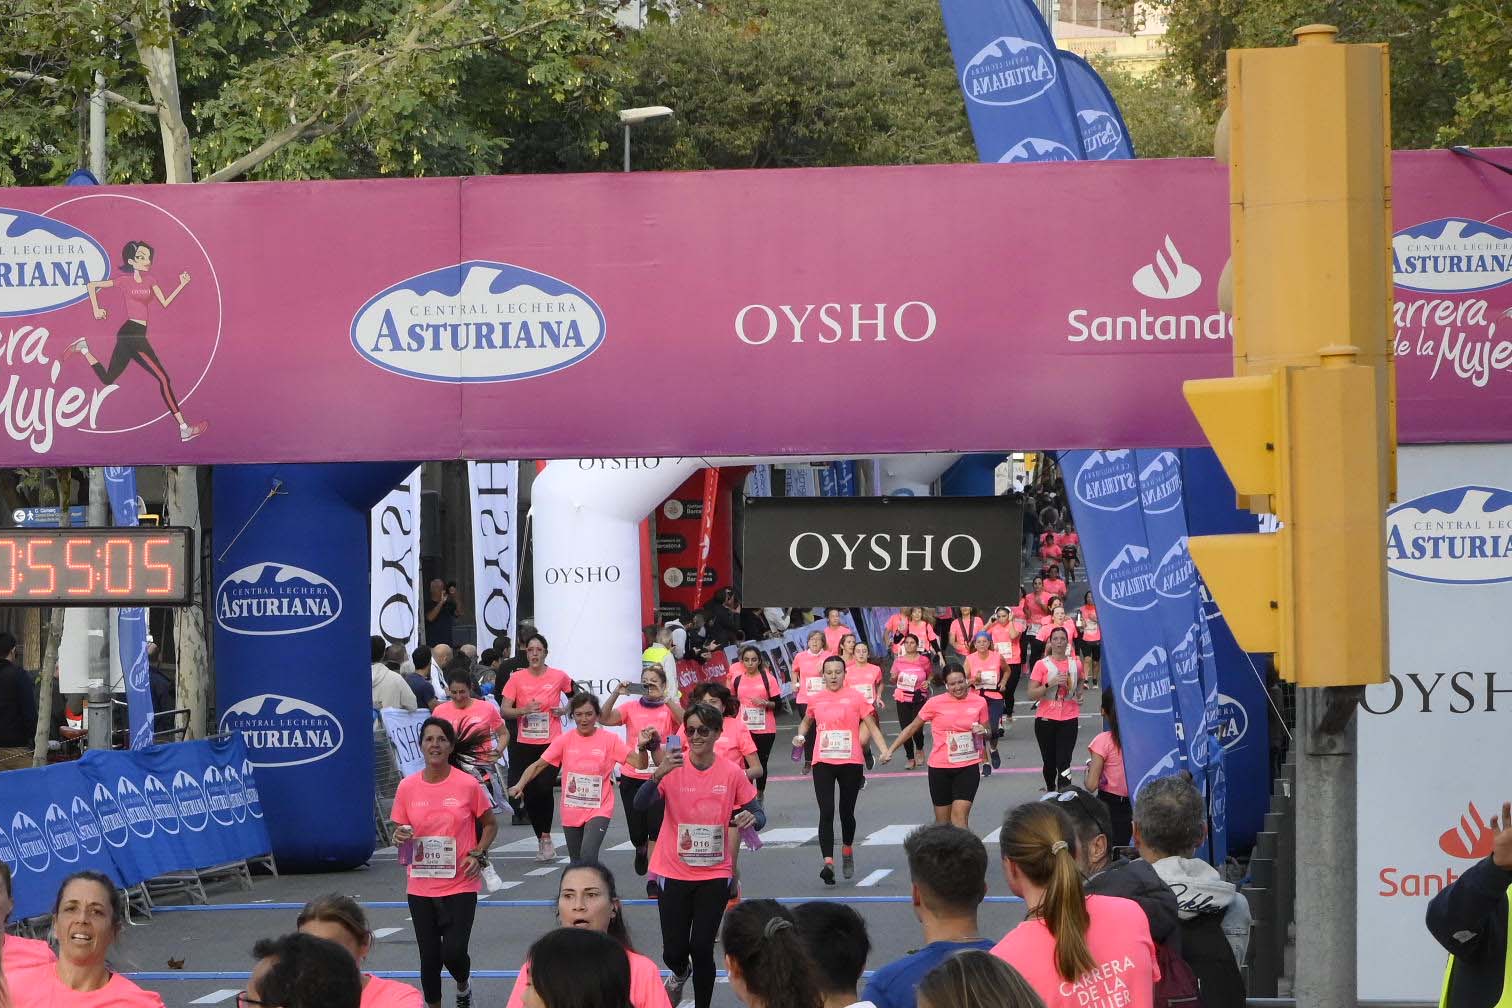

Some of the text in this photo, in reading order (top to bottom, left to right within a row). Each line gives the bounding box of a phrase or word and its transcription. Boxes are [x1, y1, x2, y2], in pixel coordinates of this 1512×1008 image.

[13, 244, 85, 256] LECHERA
[1407, 243, 1457, 252] CENTRAL
[410, 302, 578, 316] CENTRAL LECHERA
[734, 301, 937, 346] OYSHO
[1393, 299, 1488, 328] arrera
[370, 308, 586, 353] ASTURIANA
[1067, 310, 1233, 343] Santand
[1416, 328, 1434, 357] la
[1429, 326, 1512, 387] Muje
[1414, 520, 1482, 531] CENTRAL
[379, 481, 415, 644] OYS
[475, 460, 511, 638] OYSH
[788, 531, 983, 574] OYSHO
[545, 565, 621, 585] OYSHO
[219, 591, 333, 619] ASTURIANA
[232, 586, 329, 596] CENTRAL LECHERA
[1360, 671, 1512, 715] OYSH
[234, 718, 330, 728] CENTRAL LECHERA
[1059, 956, 1136, 997] CARRERA
[1077, 976, 1128, 1007] DE LA
